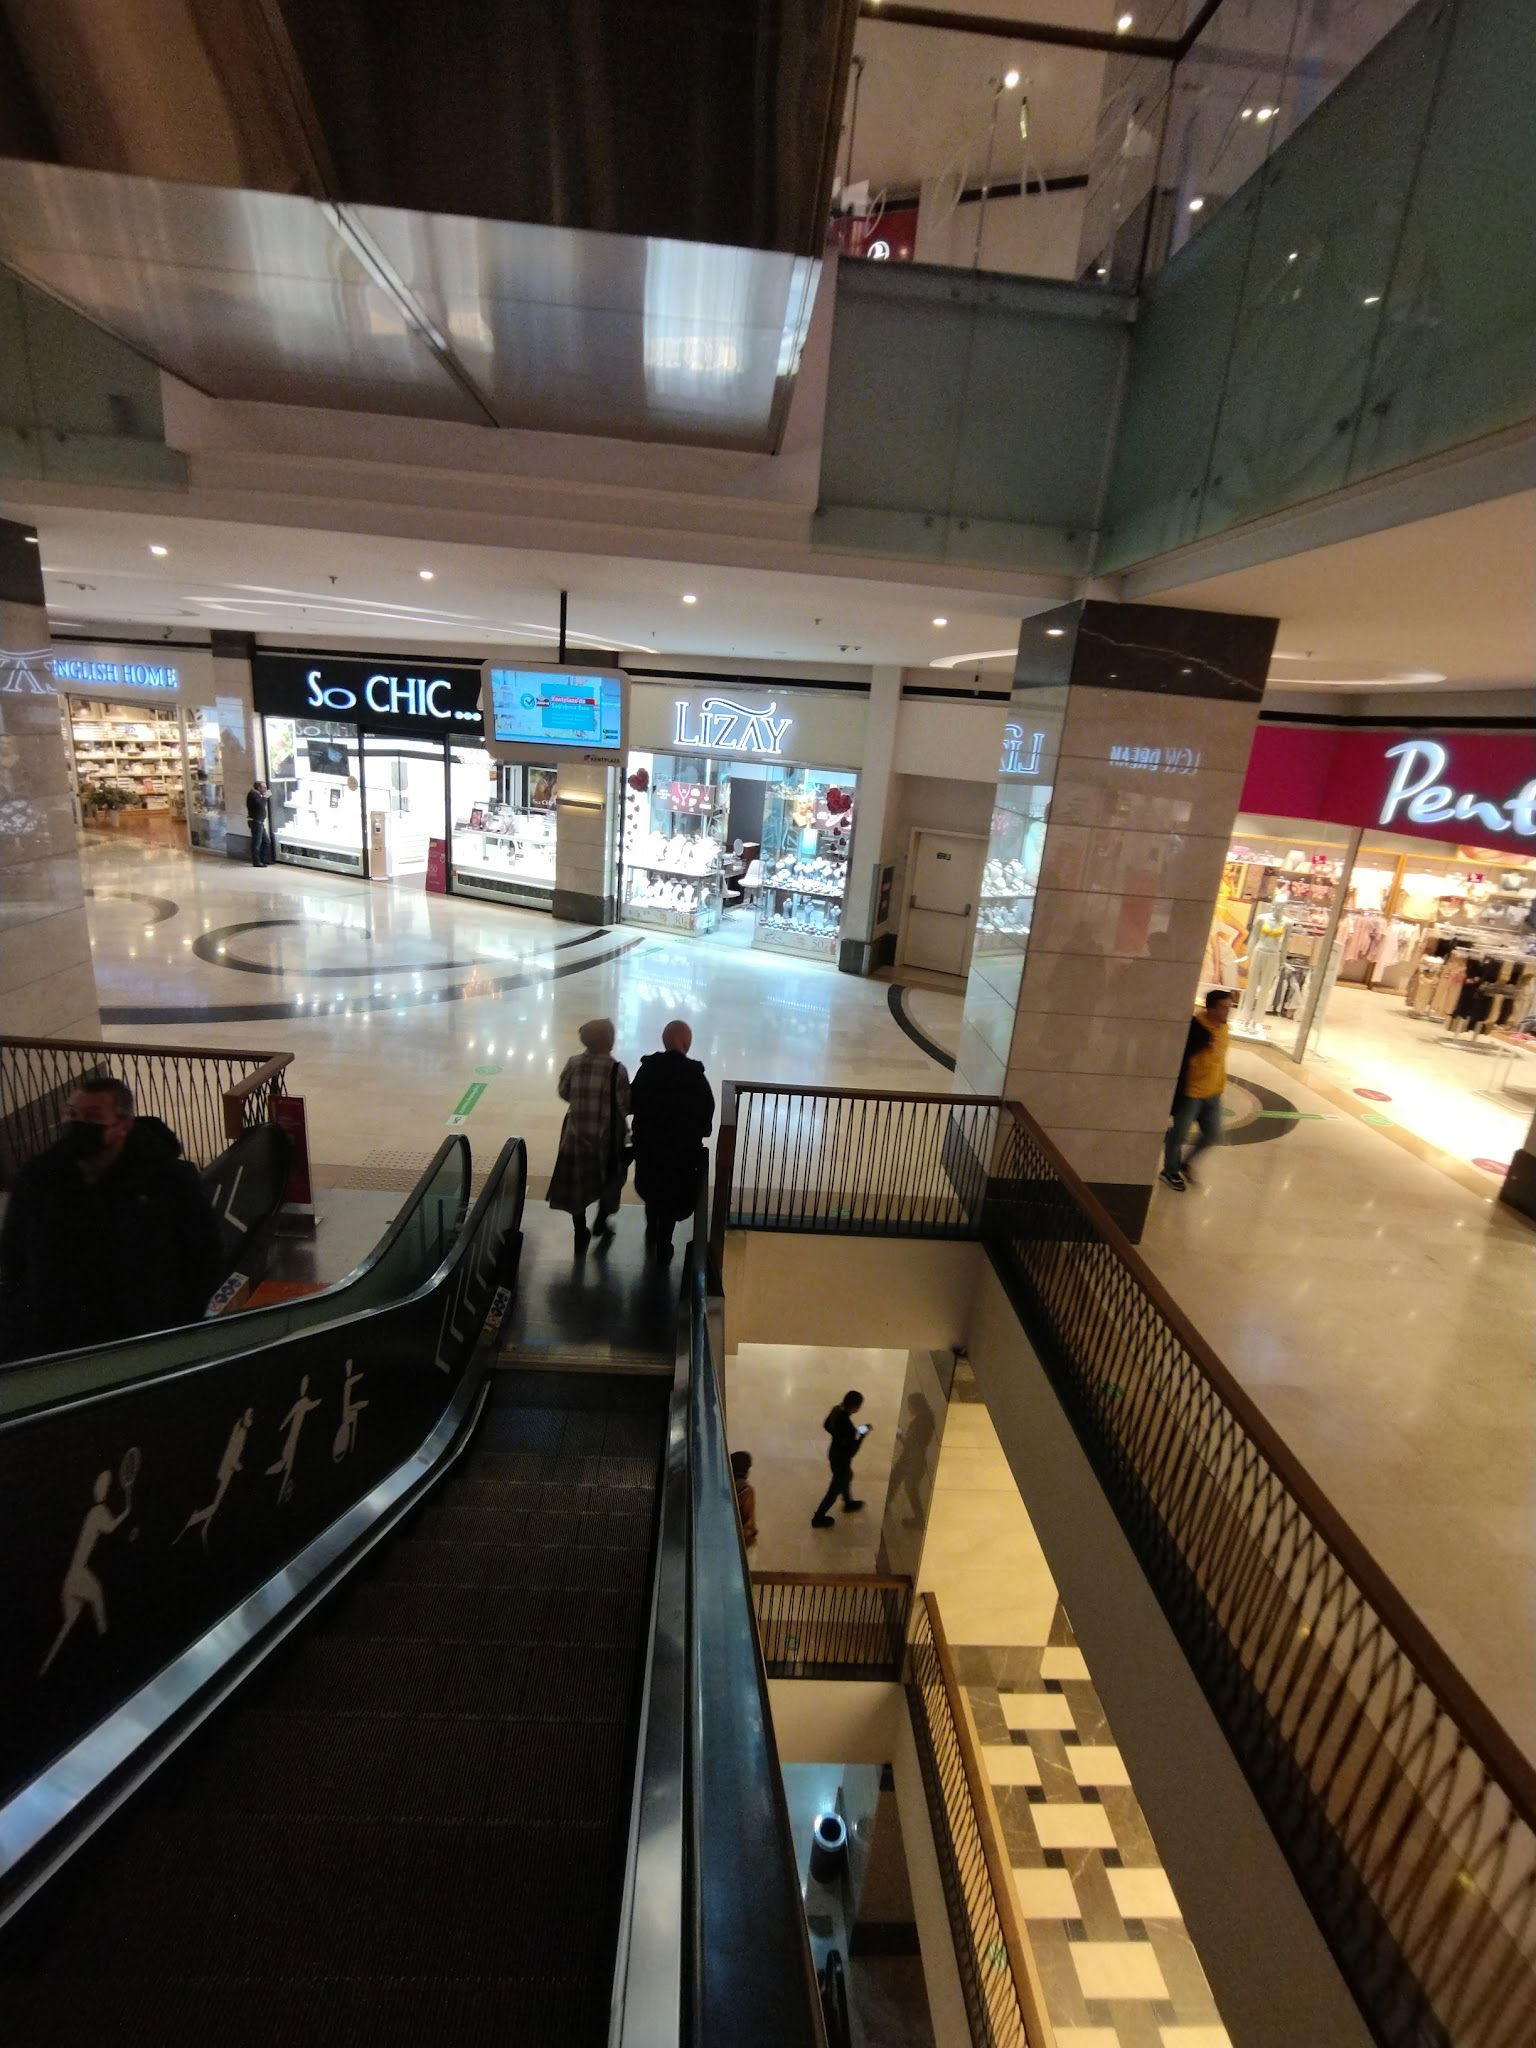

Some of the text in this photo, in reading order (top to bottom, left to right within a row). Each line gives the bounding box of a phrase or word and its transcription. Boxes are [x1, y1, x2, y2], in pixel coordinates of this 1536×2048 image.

[53, 659, 118, 682] NGLISH
[123, 664, 178, 688] HOME
[673, 697, 793, 754] LIZAY
